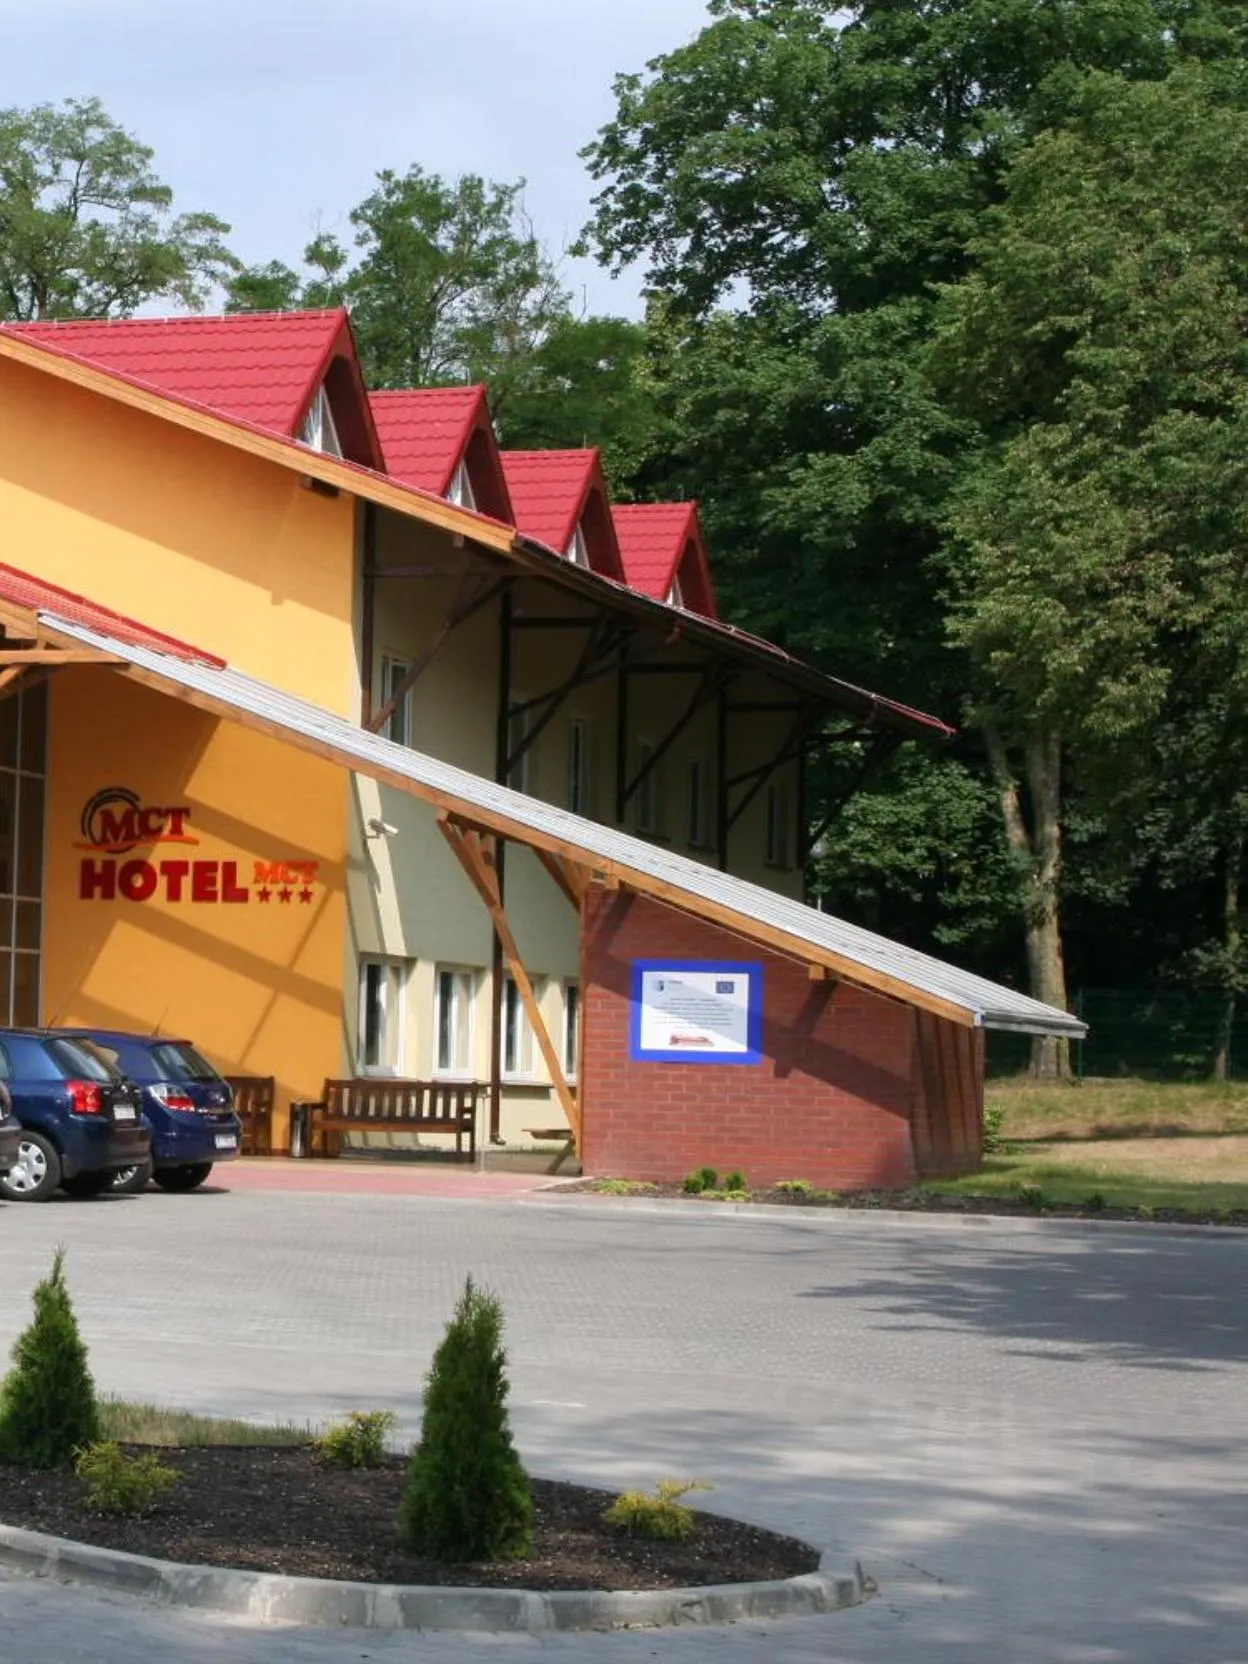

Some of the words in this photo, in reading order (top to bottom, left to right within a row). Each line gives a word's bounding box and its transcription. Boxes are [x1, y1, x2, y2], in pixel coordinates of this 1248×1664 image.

[99, 806, 191, 843] MCT
[79, 858, 249, 904] HOTEL
[253, 860, 320, 885] MCT
